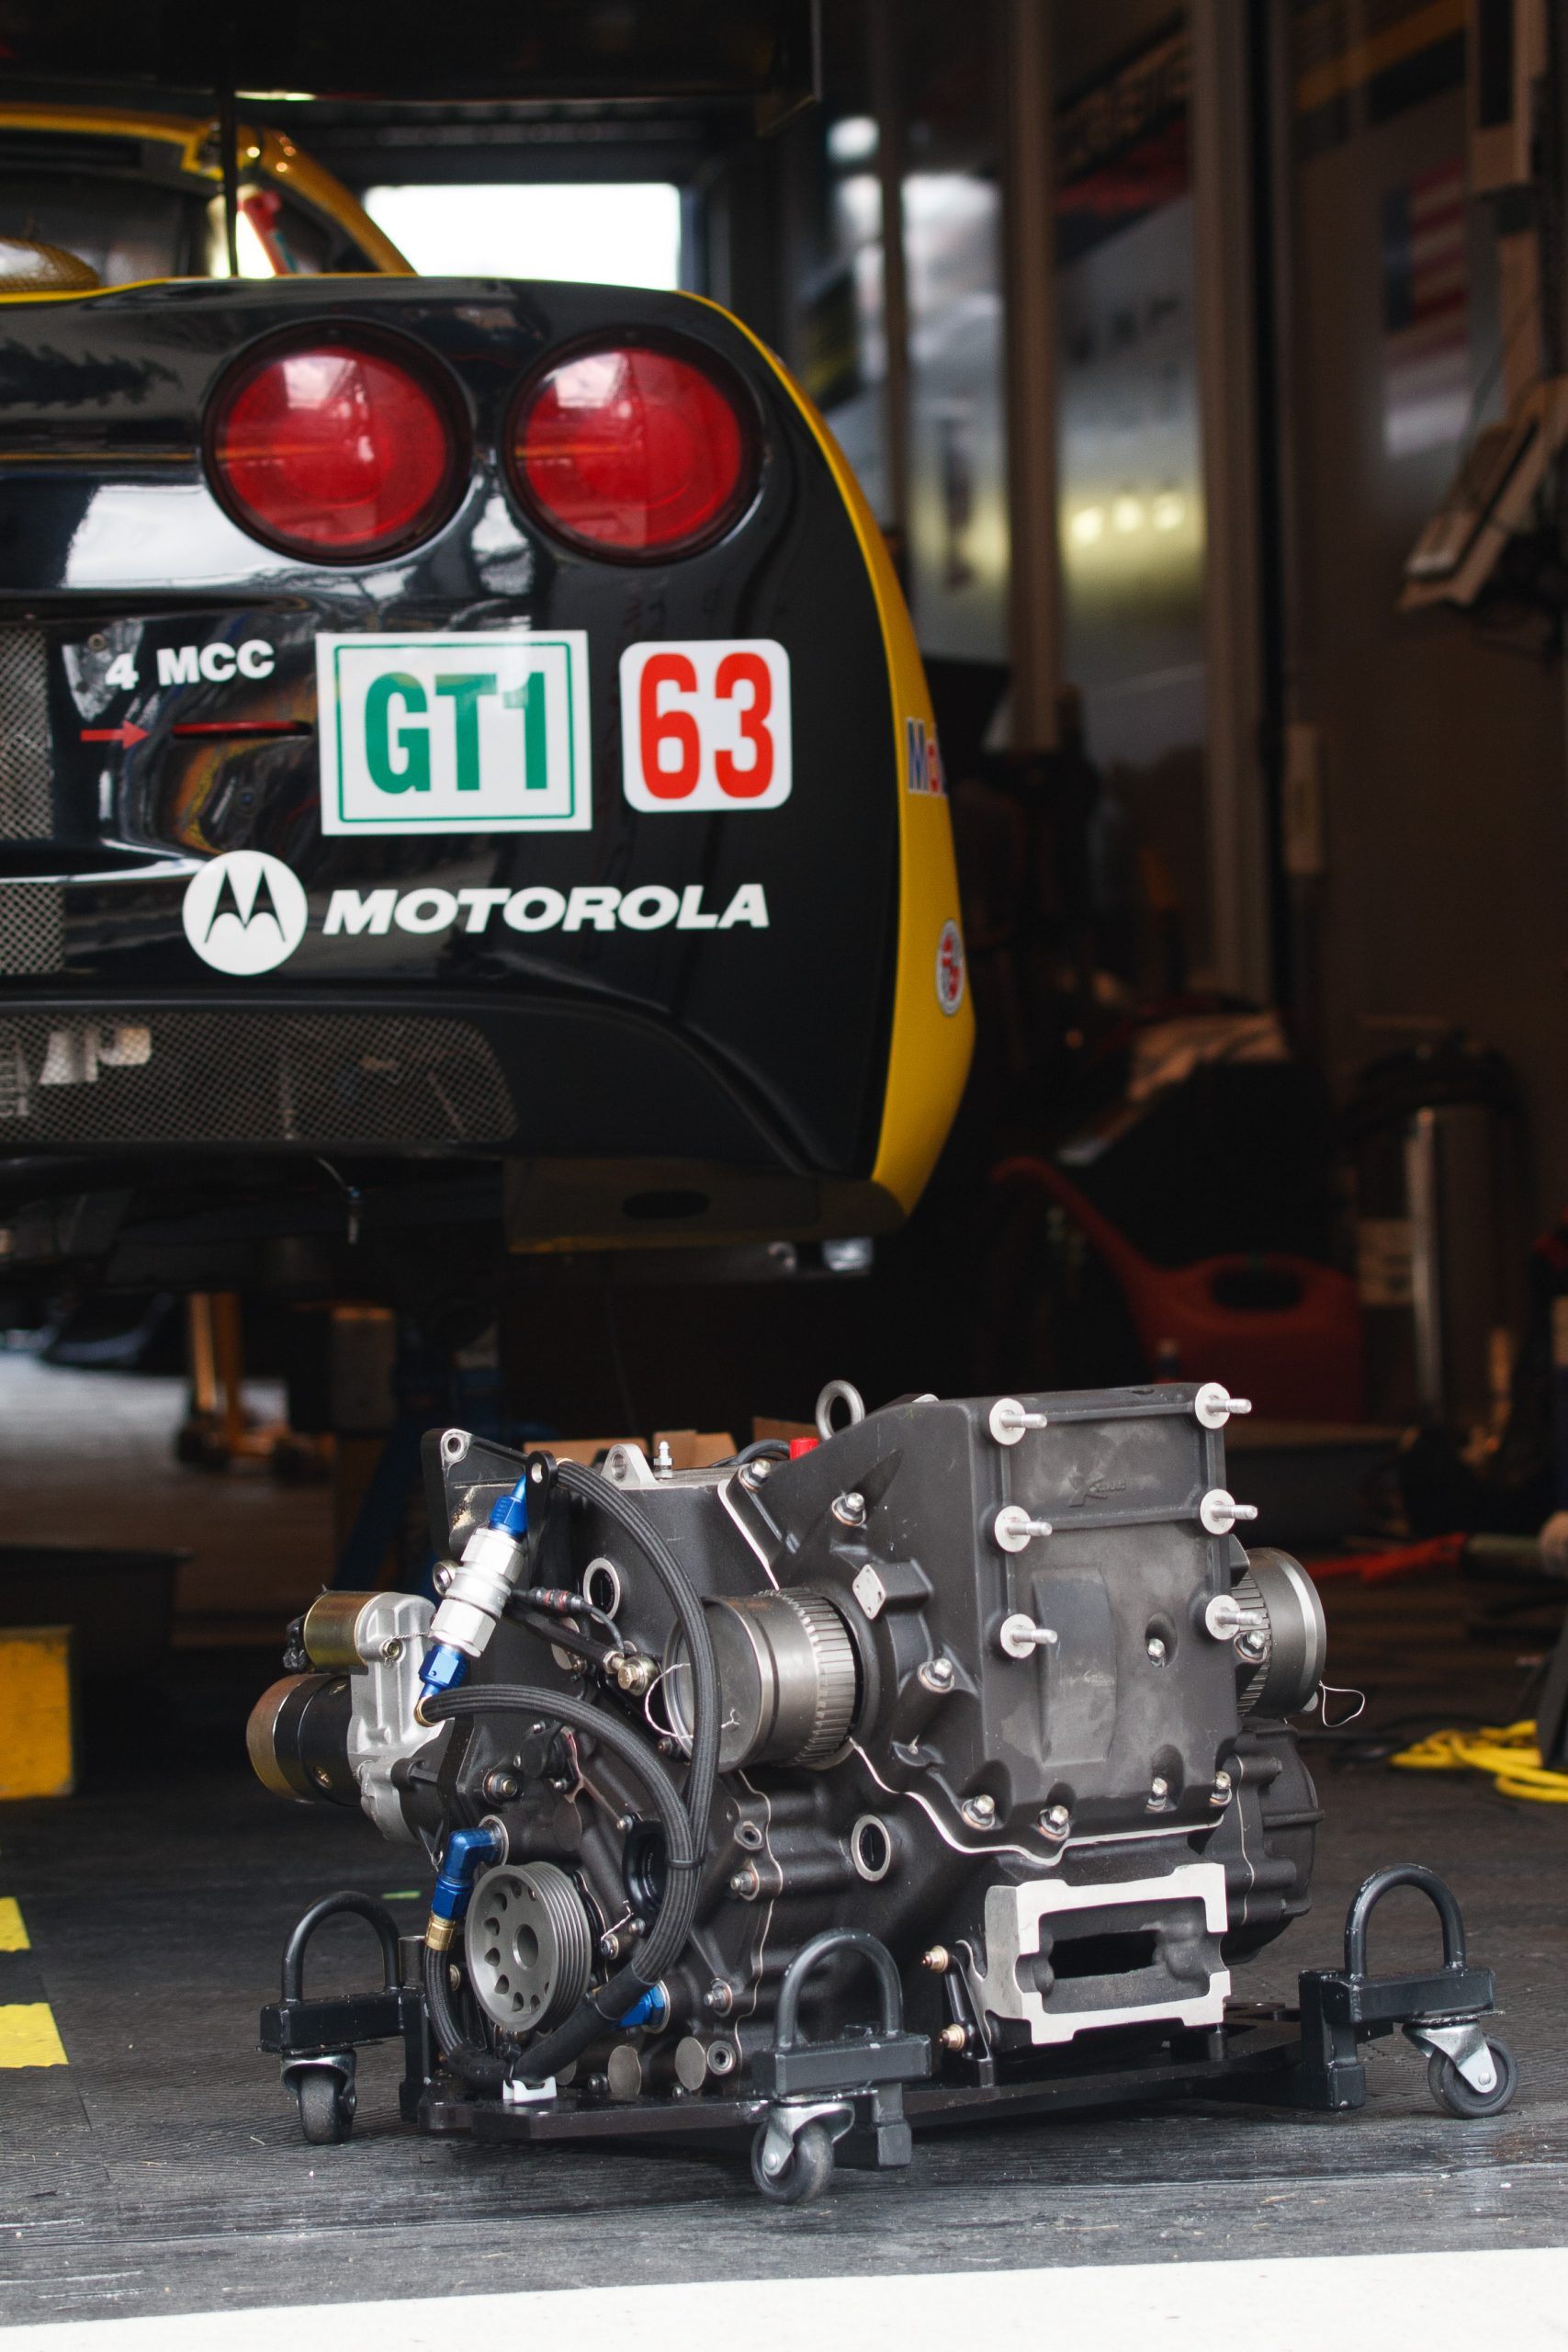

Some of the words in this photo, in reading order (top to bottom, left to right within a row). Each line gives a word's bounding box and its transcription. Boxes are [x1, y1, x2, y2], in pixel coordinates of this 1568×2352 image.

[105, 653, 140, 690] 4
[156, 639, 275, 686] MCC
[366, 672, 548, 795] GT1
[639, 651, 774, 799] 63
[322, 884, 770, 935] MOTOROLA
